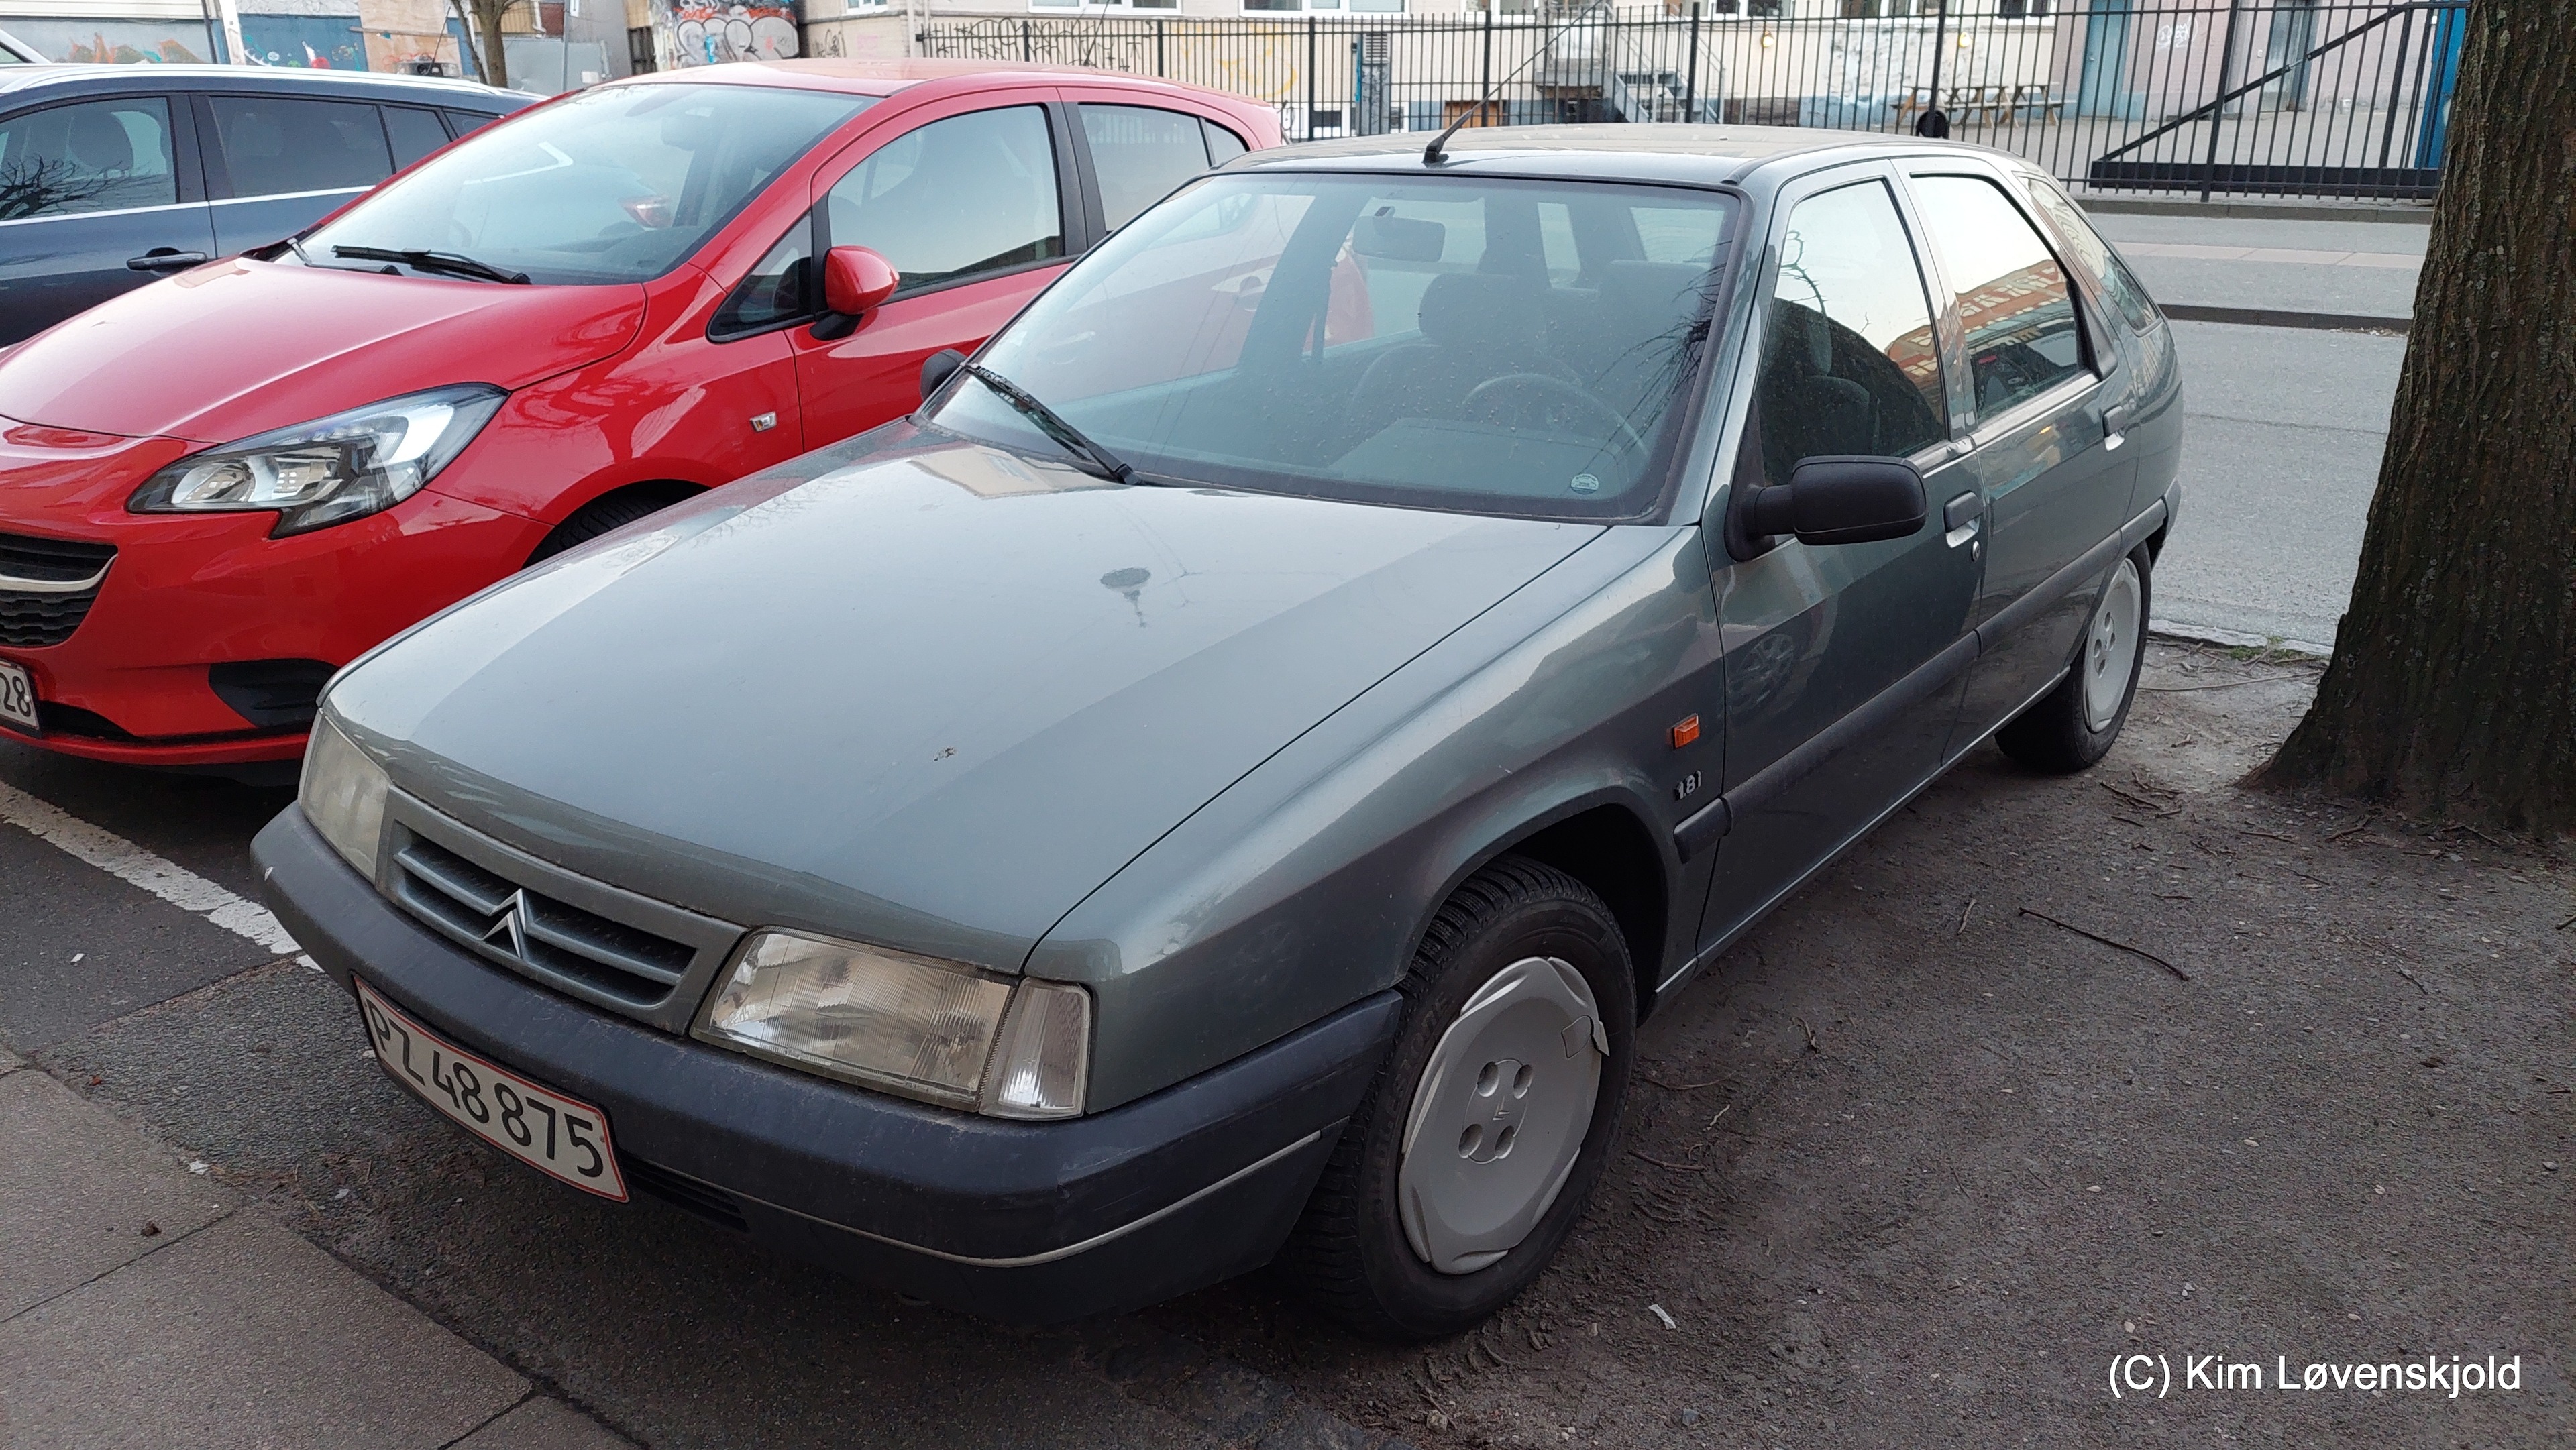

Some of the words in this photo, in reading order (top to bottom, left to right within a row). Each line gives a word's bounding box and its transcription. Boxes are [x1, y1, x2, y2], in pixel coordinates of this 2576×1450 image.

[365, 997, 425, 1086] PZ
[433, 1050, 490, 1124] 48
[494, 1082, 604, 1178] 875
